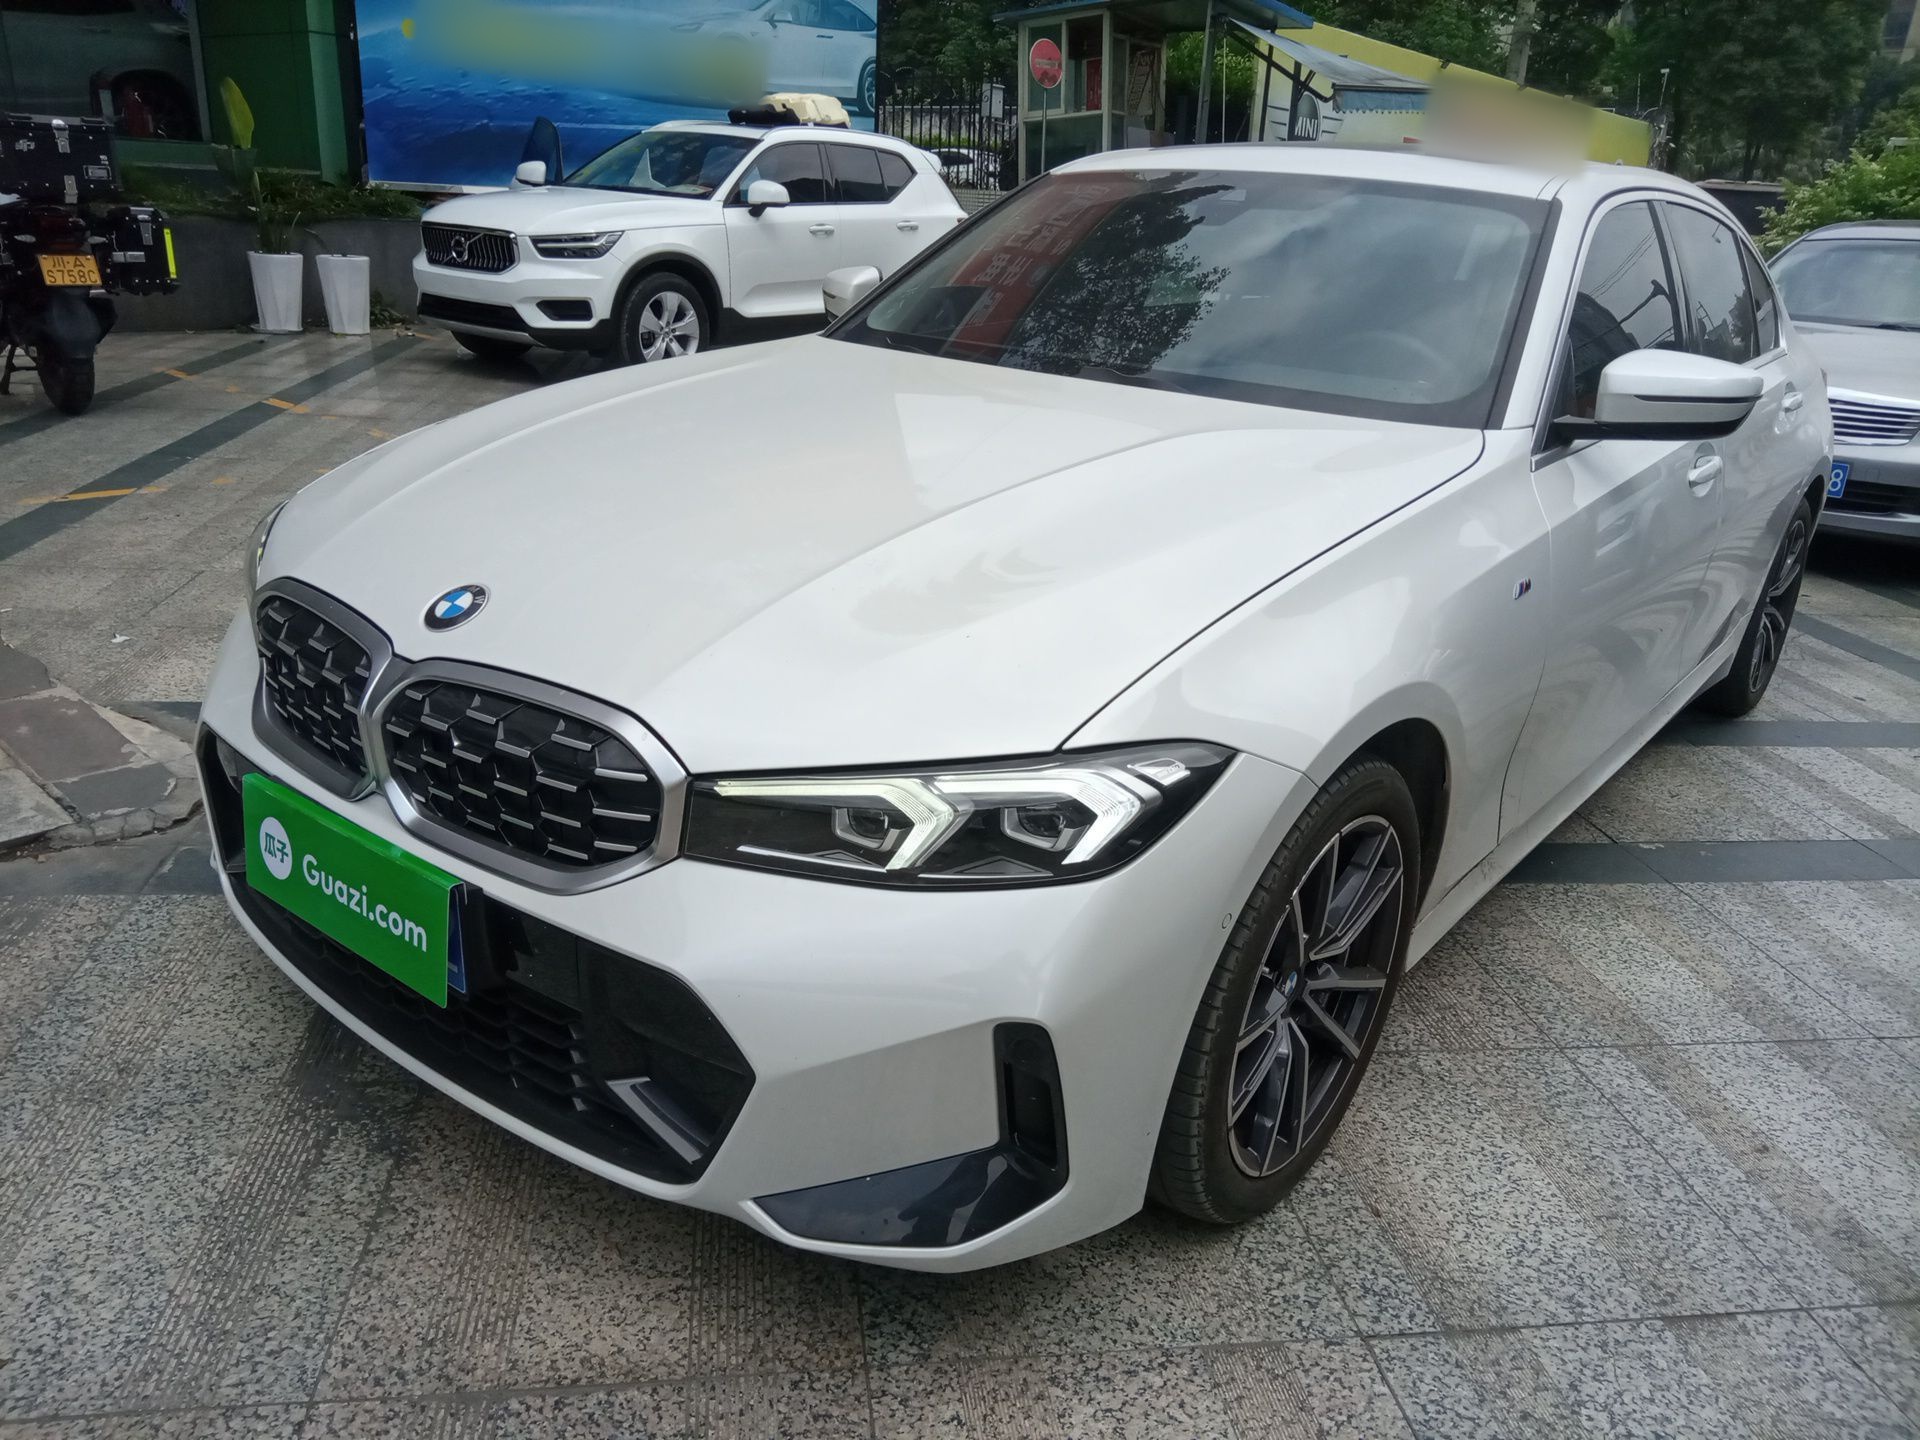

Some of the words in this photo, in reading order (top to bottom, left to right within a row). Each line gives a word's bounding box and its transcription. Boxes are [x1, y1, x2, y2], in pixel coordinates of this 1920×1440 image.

[46, 269, 98, 284] S758C
[264, 832, 289, 863] 瓜子
[302, 854, 427, 952] Guazi.com
